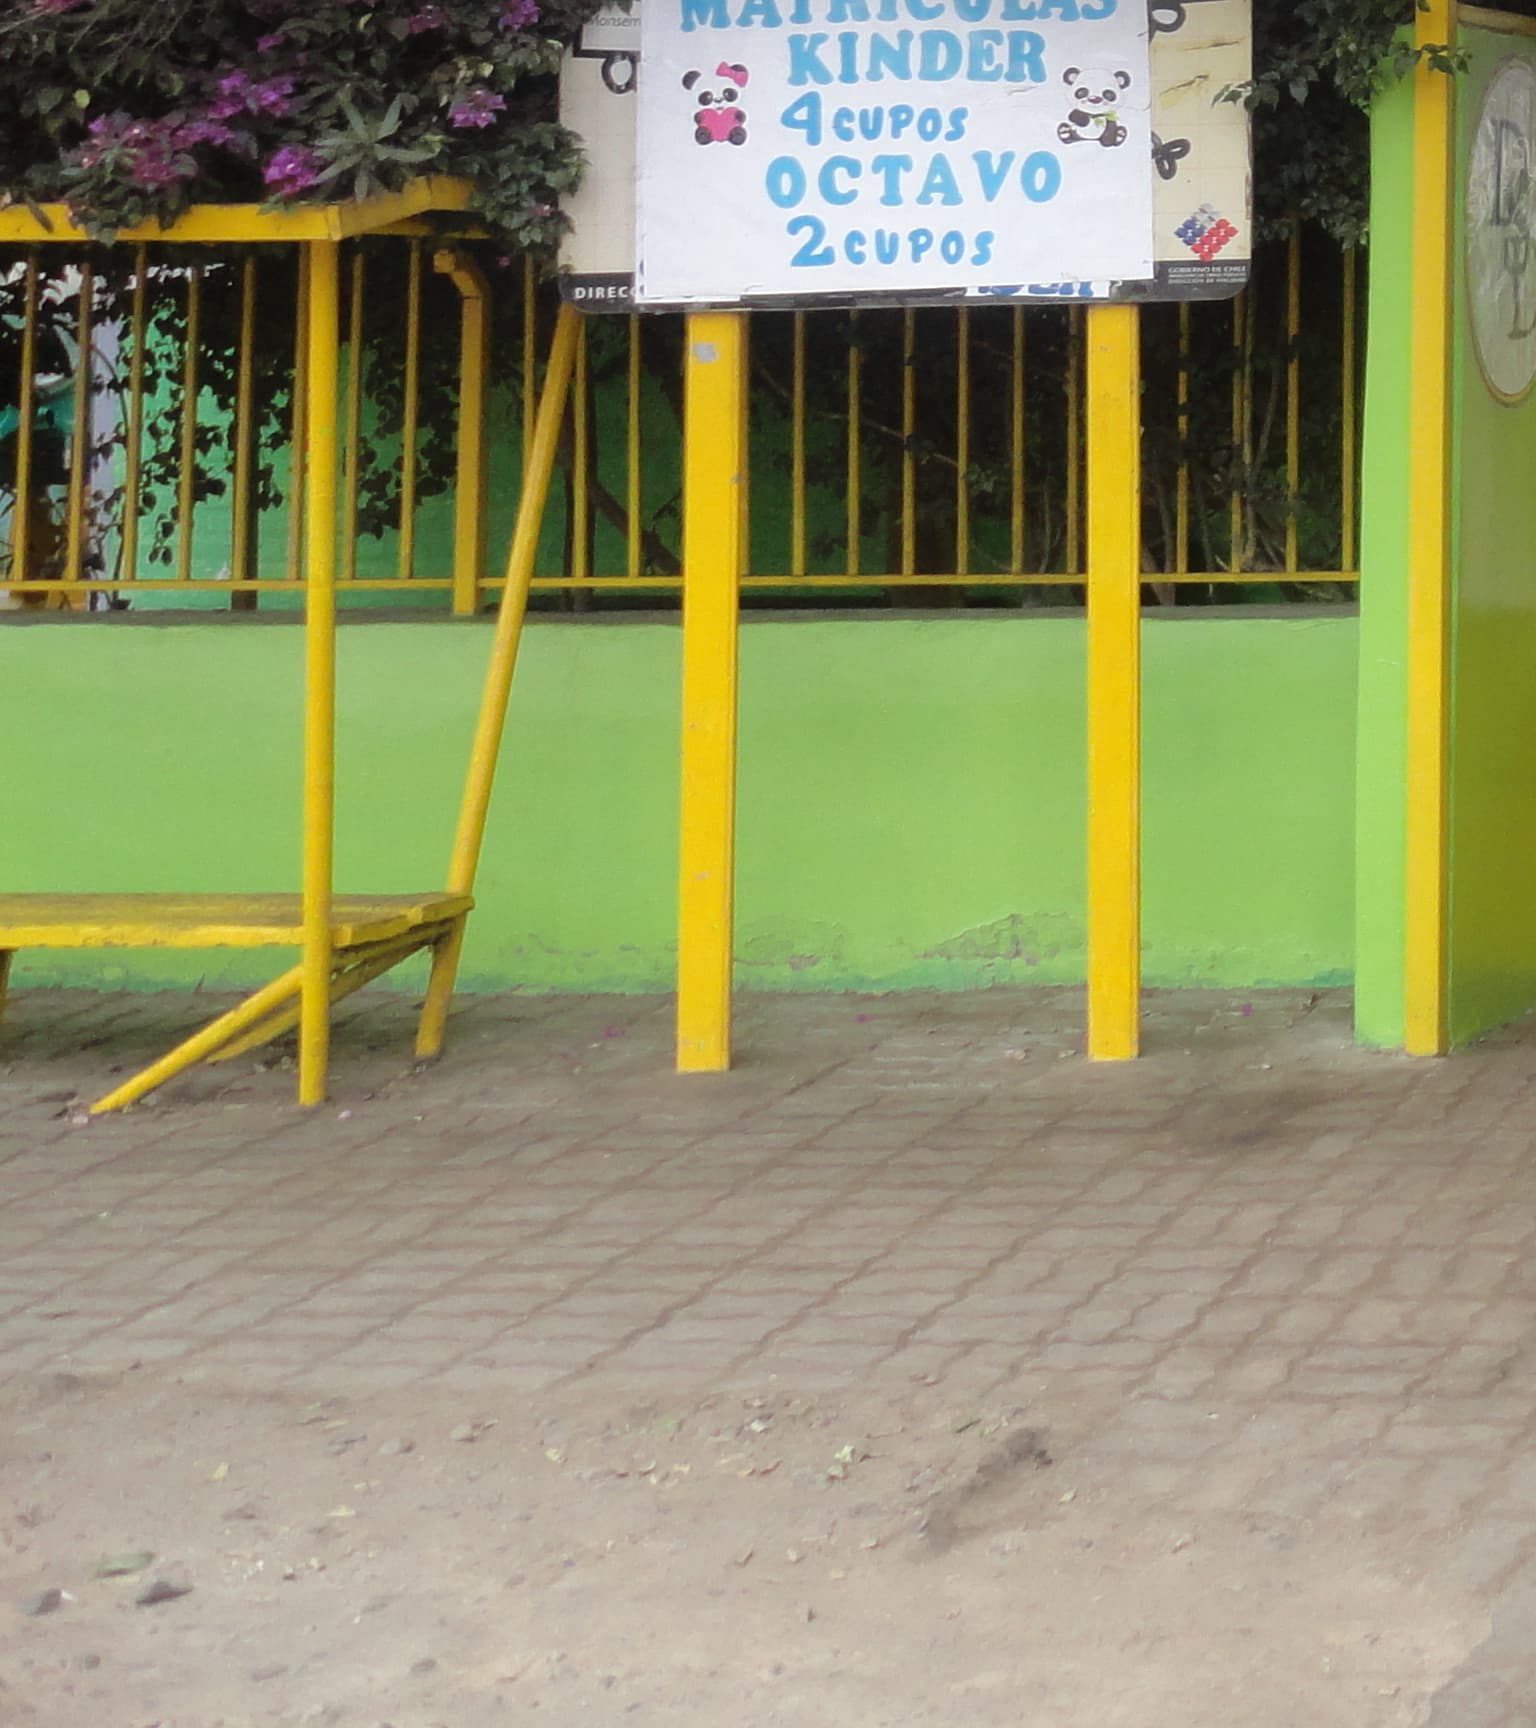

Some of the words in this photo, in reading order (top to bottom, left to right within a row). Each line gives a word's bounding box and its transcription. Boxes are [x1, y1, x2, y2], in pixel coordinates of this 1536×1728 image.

[787, 29, 1047, 86] KINDER
[780, 91, 823, 146] 4
[832, 104, 969, 142] CUPOS
[765, 150, 1062, 209] OCTAVO
[786, 214, 836, 267] 2
[844, 227, 995, 266] CUPOS
